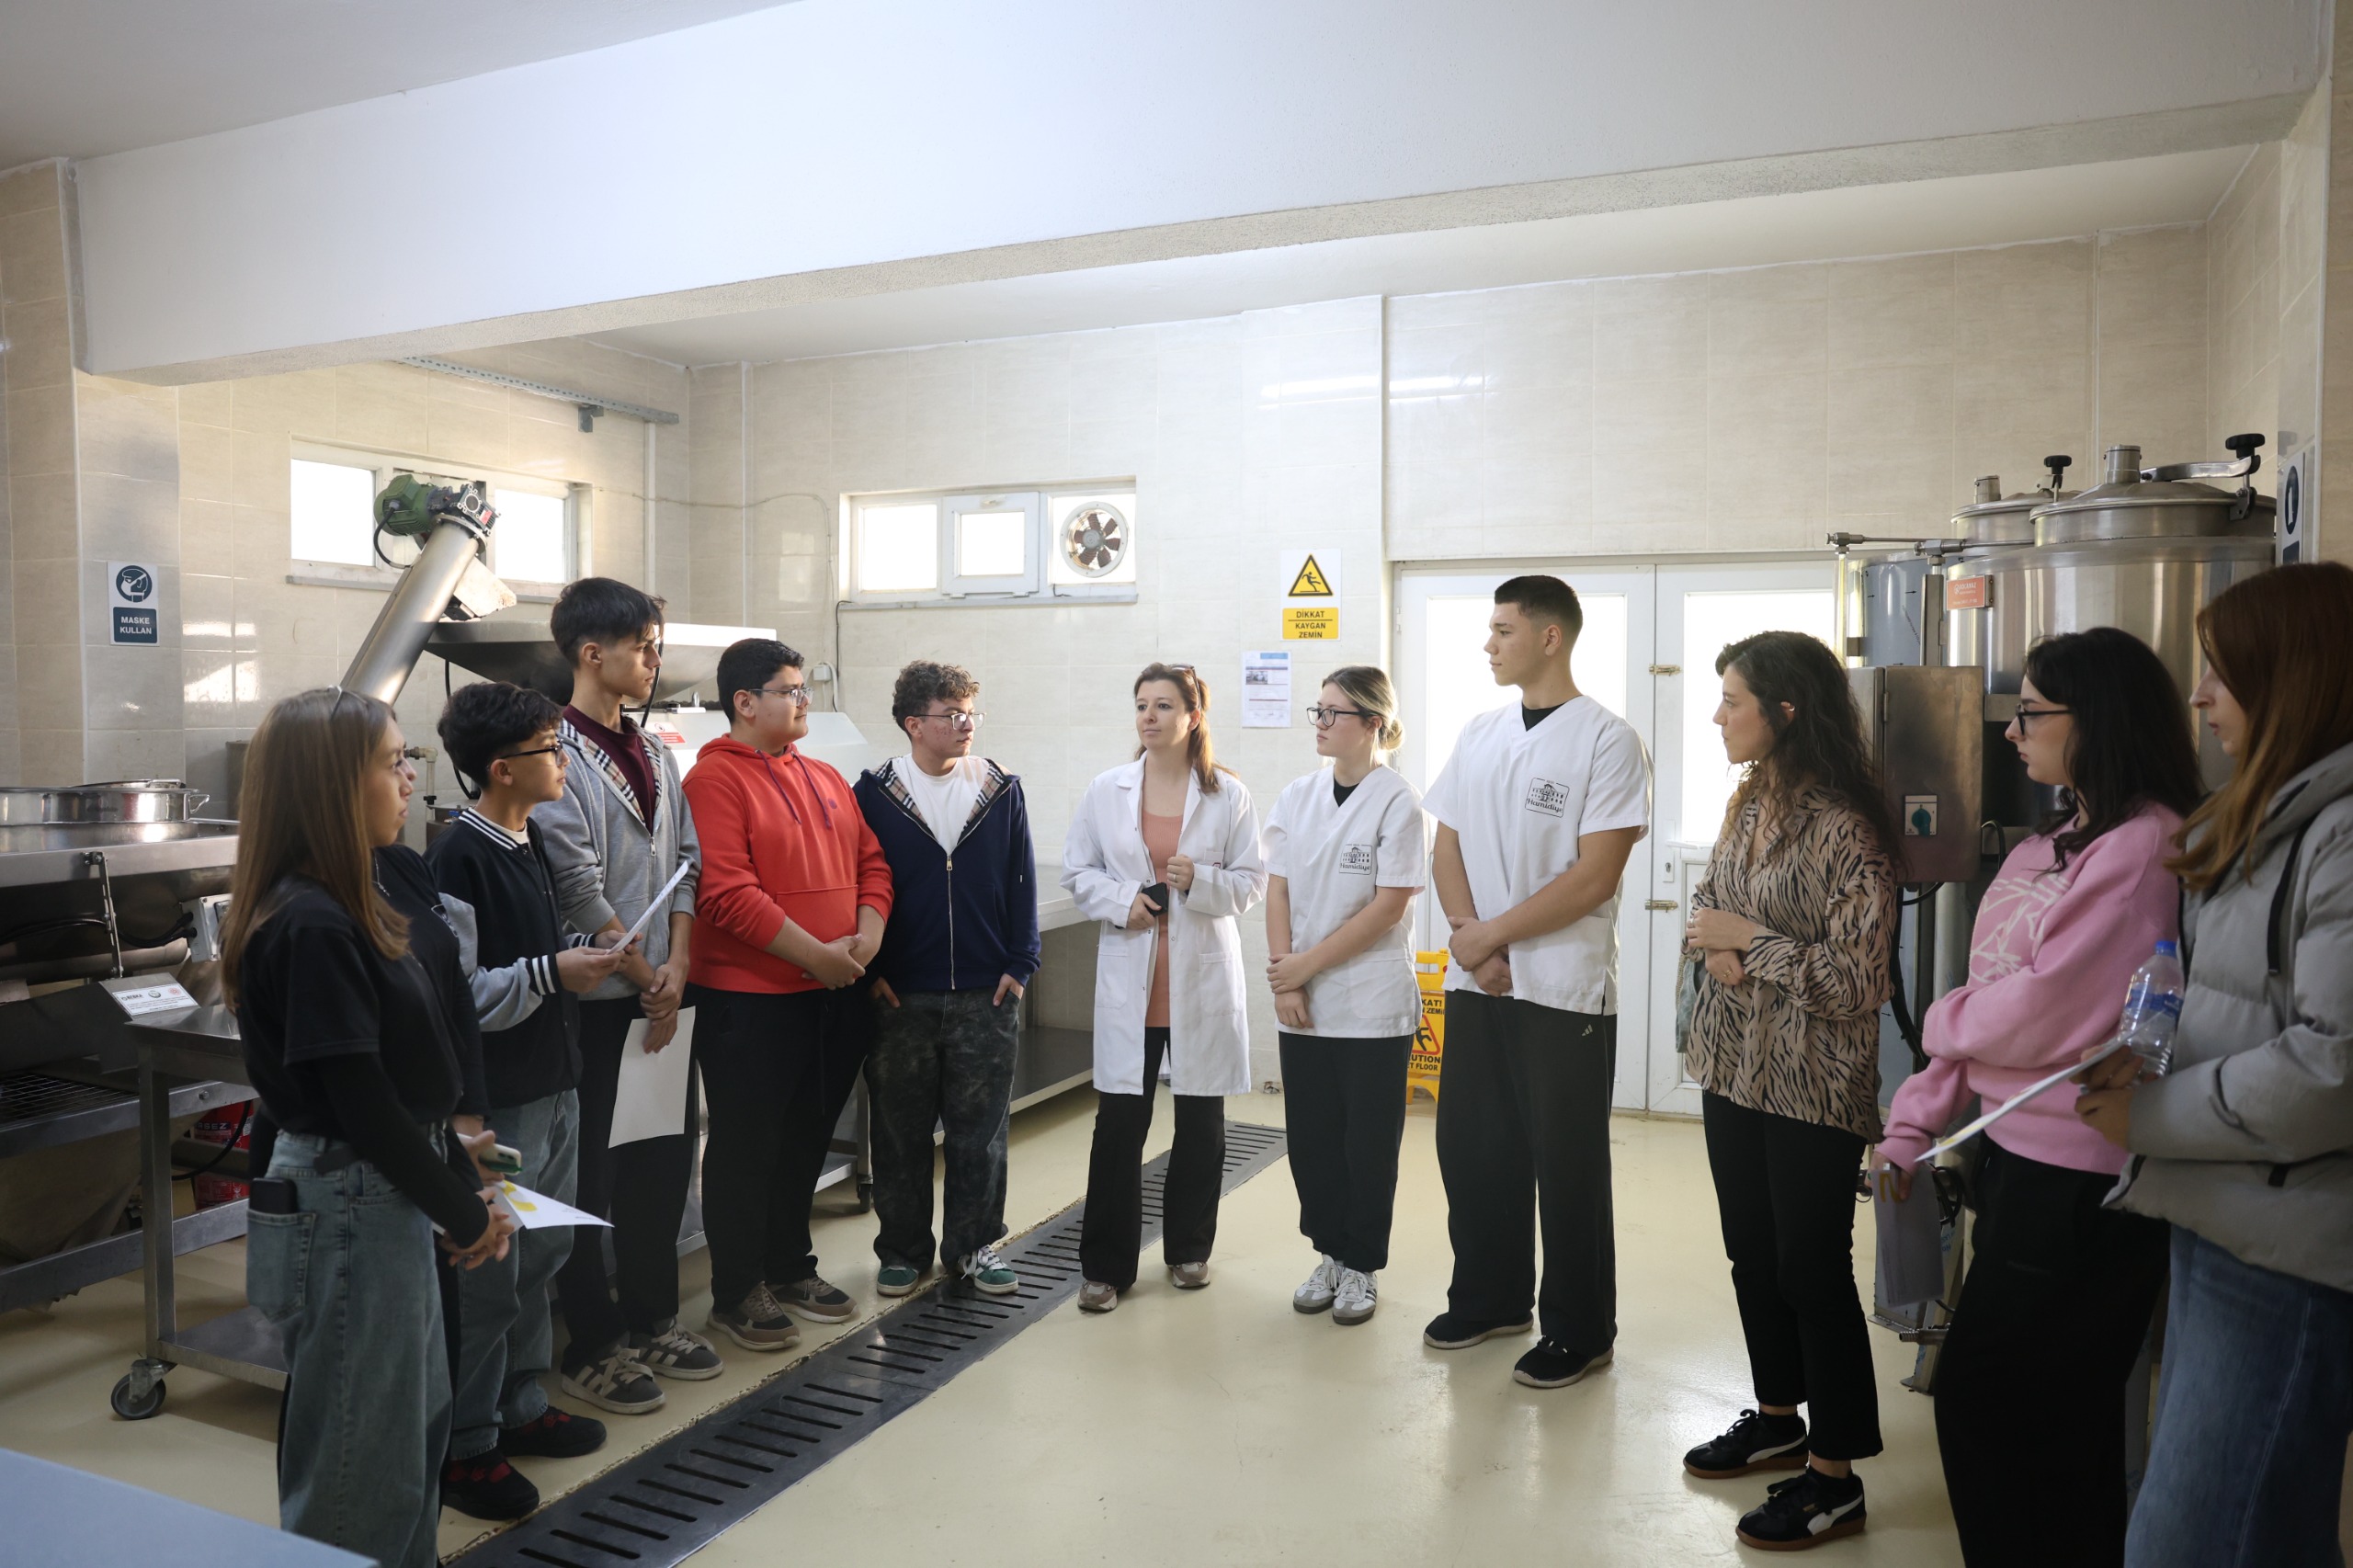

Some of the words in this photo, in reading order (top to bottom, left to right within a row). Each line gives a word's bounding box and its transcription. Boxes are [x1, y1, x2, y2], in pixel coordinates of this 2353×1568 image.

[1296, 609, 1324, 619] DİKKAT
[120, 616, 150, 625] MASKE
[119, 627, 153, 635] KULLAN
[1299, 631, 1323, 639] ZEMİN
[1526, 798, 1563, 812] Hamidiye
[1339, 862, 1371, 871] Hamidiye
[1421, 998, 1442, 1007] KAT!
[1409, 1053, 1441, 1063] UTION
[1415, 1062, 1438, 1071] FLOOR
